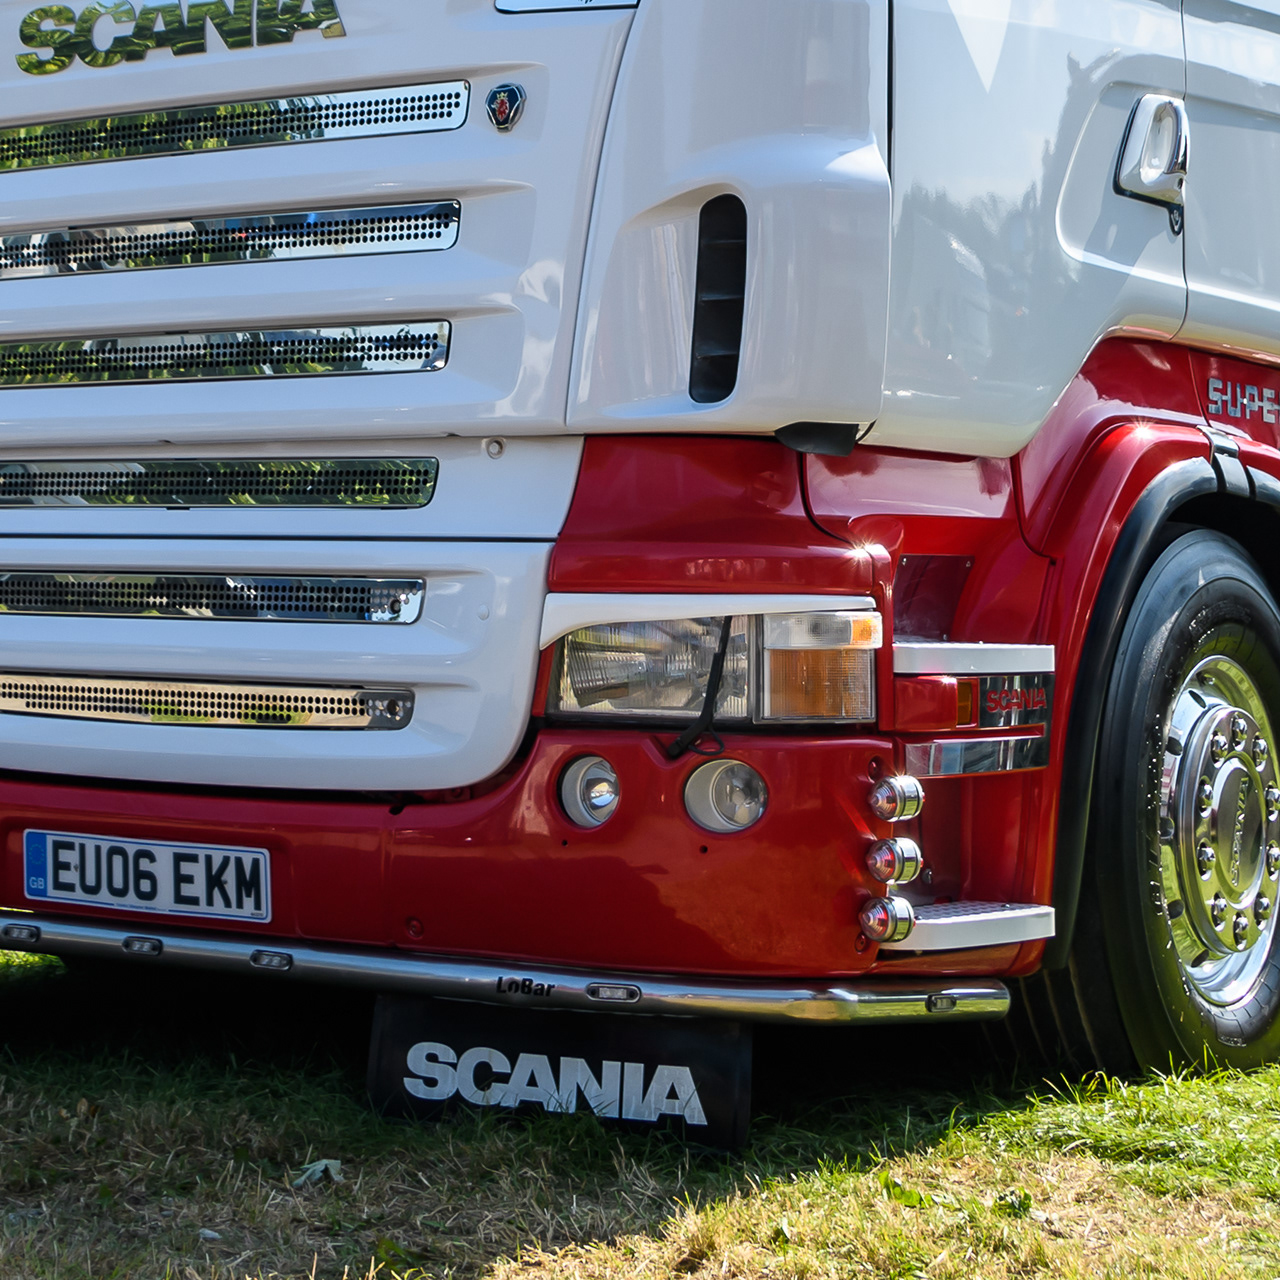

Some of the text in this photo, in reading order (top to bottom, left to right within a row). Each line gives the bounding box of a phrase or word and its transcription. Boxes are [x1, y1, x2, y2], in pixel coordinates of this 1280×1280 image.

[986, 688, 1048, 713] SCANIA
[29, 876, 45, 890] GB
[52, 839, 263, 912] EU06 EKM
[496, 976, 556, 997] LoBar
[403, 1041, 709, 1126] SCANIA
